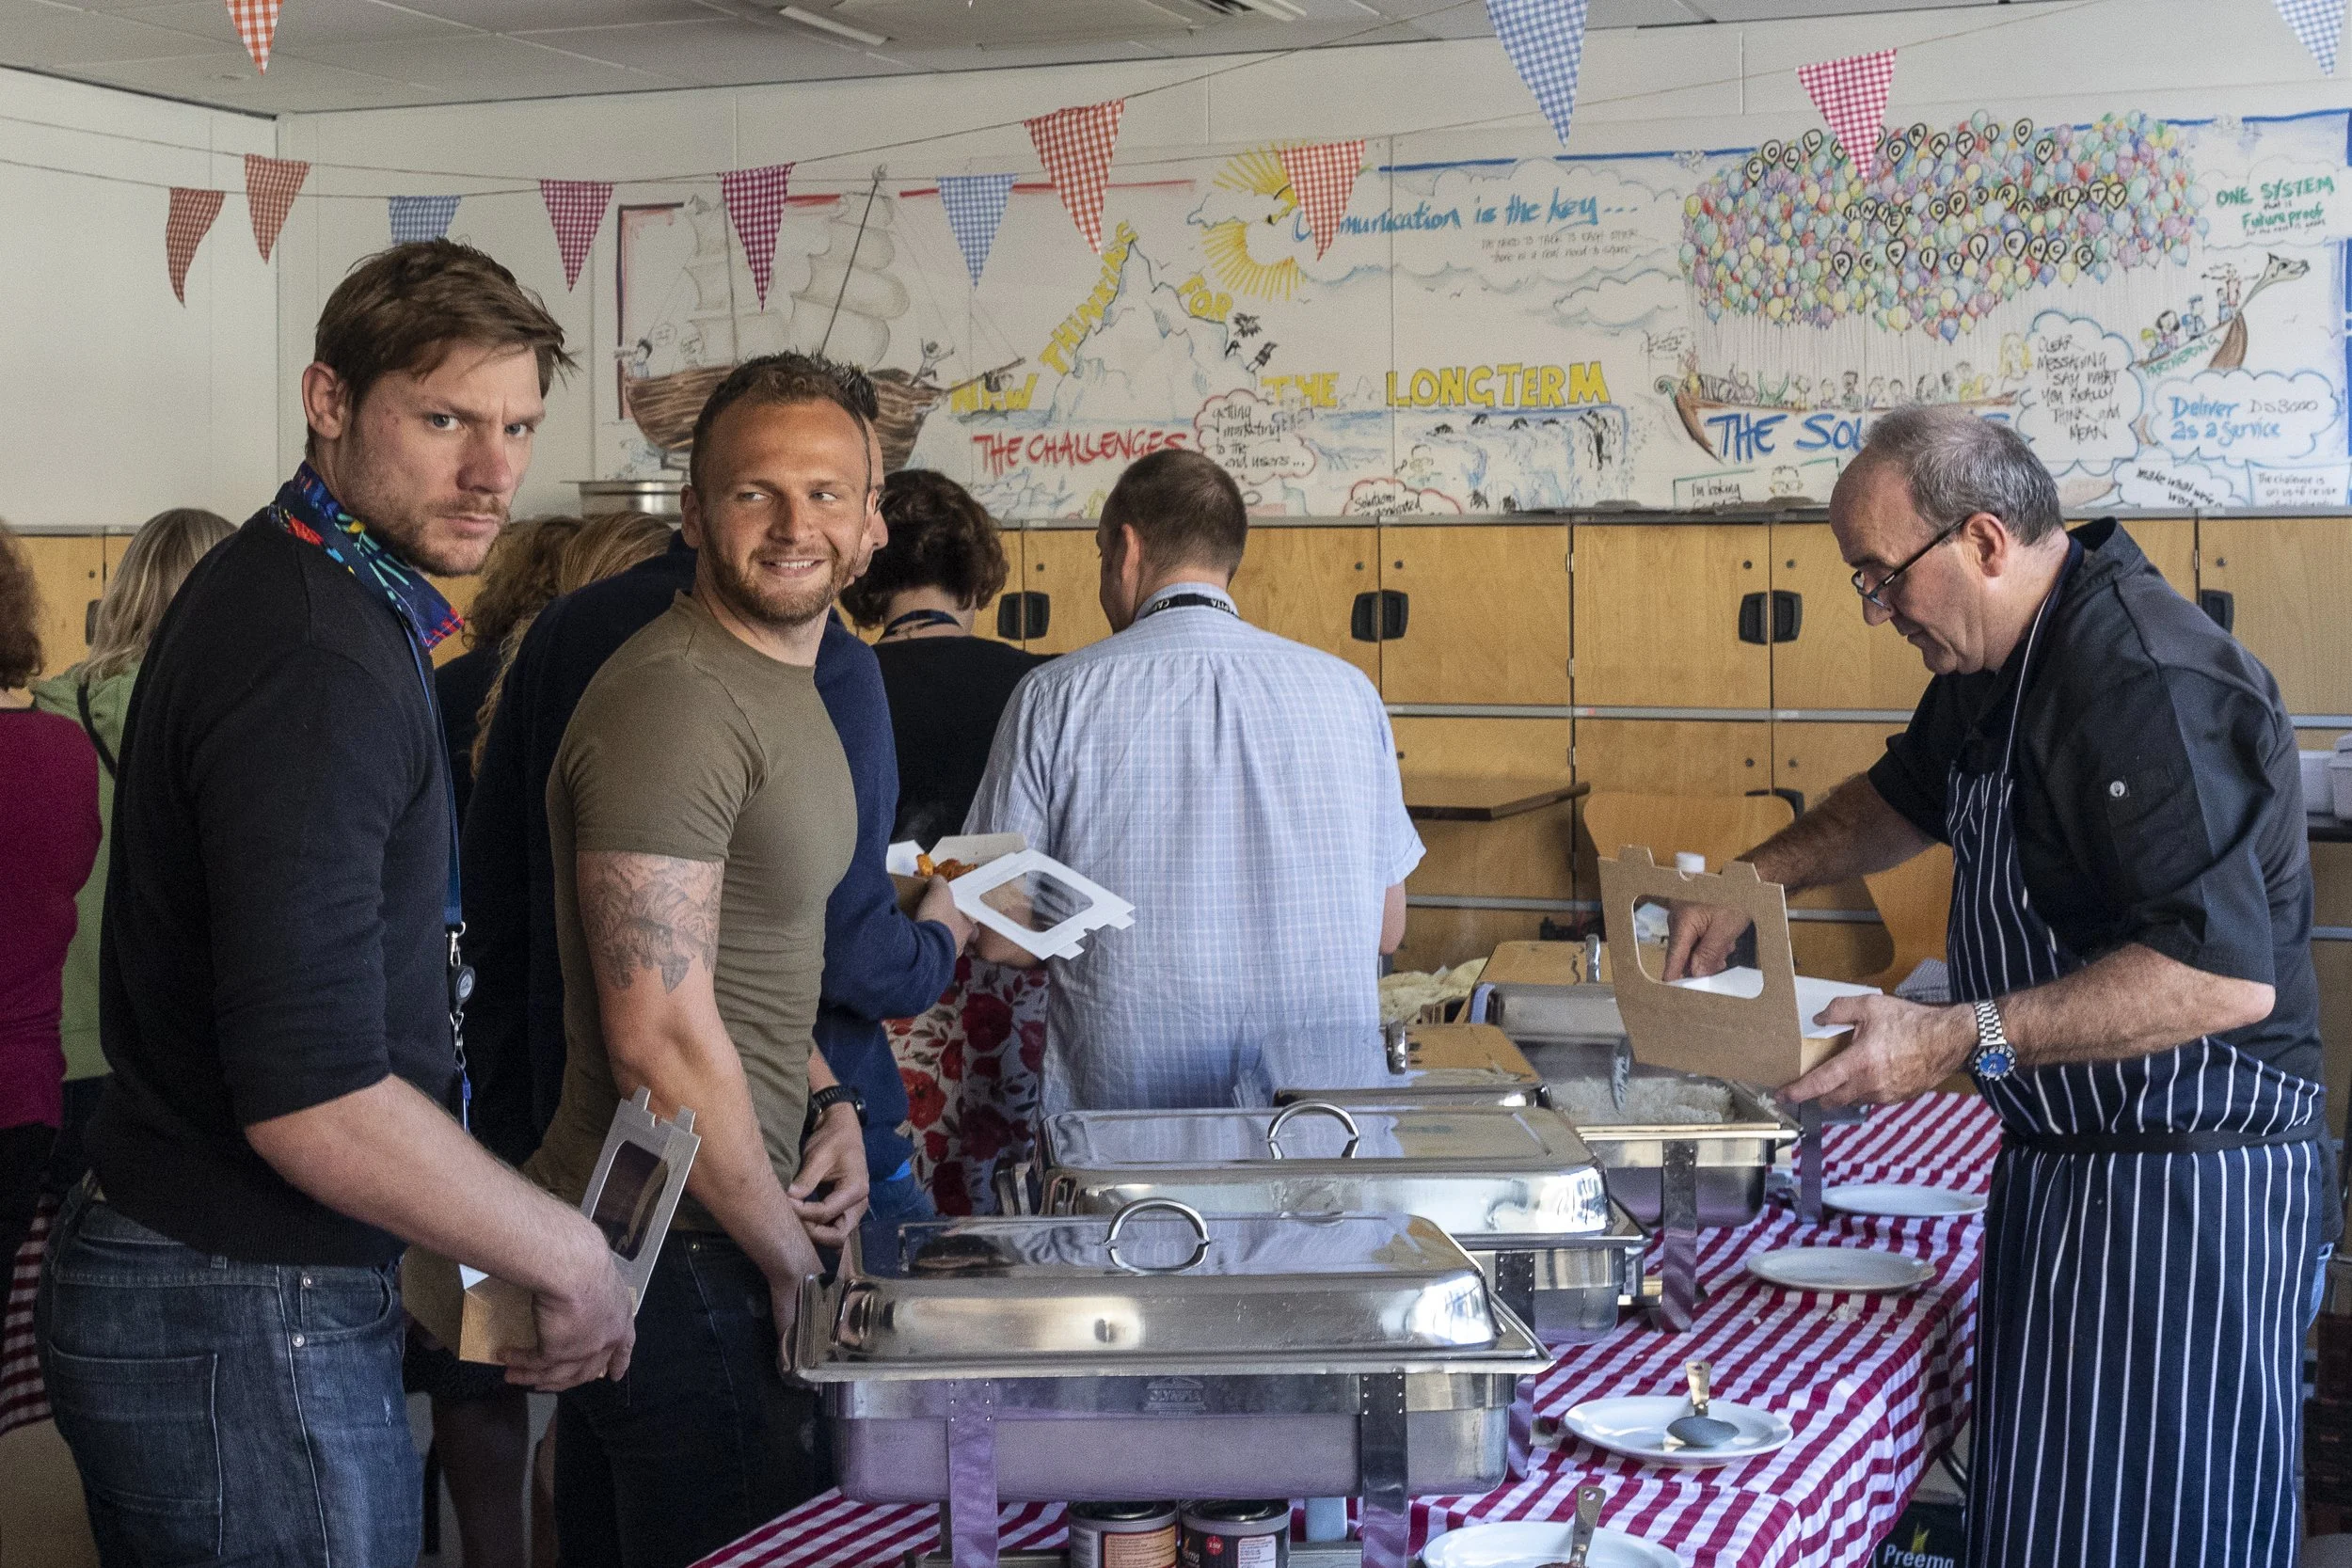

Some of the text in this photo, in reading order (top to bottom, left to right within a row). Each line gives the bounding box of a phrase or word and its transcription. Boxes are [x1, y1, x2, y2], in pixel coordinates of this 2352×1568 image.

[2216, 176, 2335, 207] ONE SYSTEM
[1474, 196, 1497, 224] is
[1505, 194, 1540, 227] the
[1177, 274, 1233, 322] FOR
[2169, 392, 2239, 420] Deliver
[972, 434, 1021, 476] THE
[1706, 413, 1788, 463] THE
